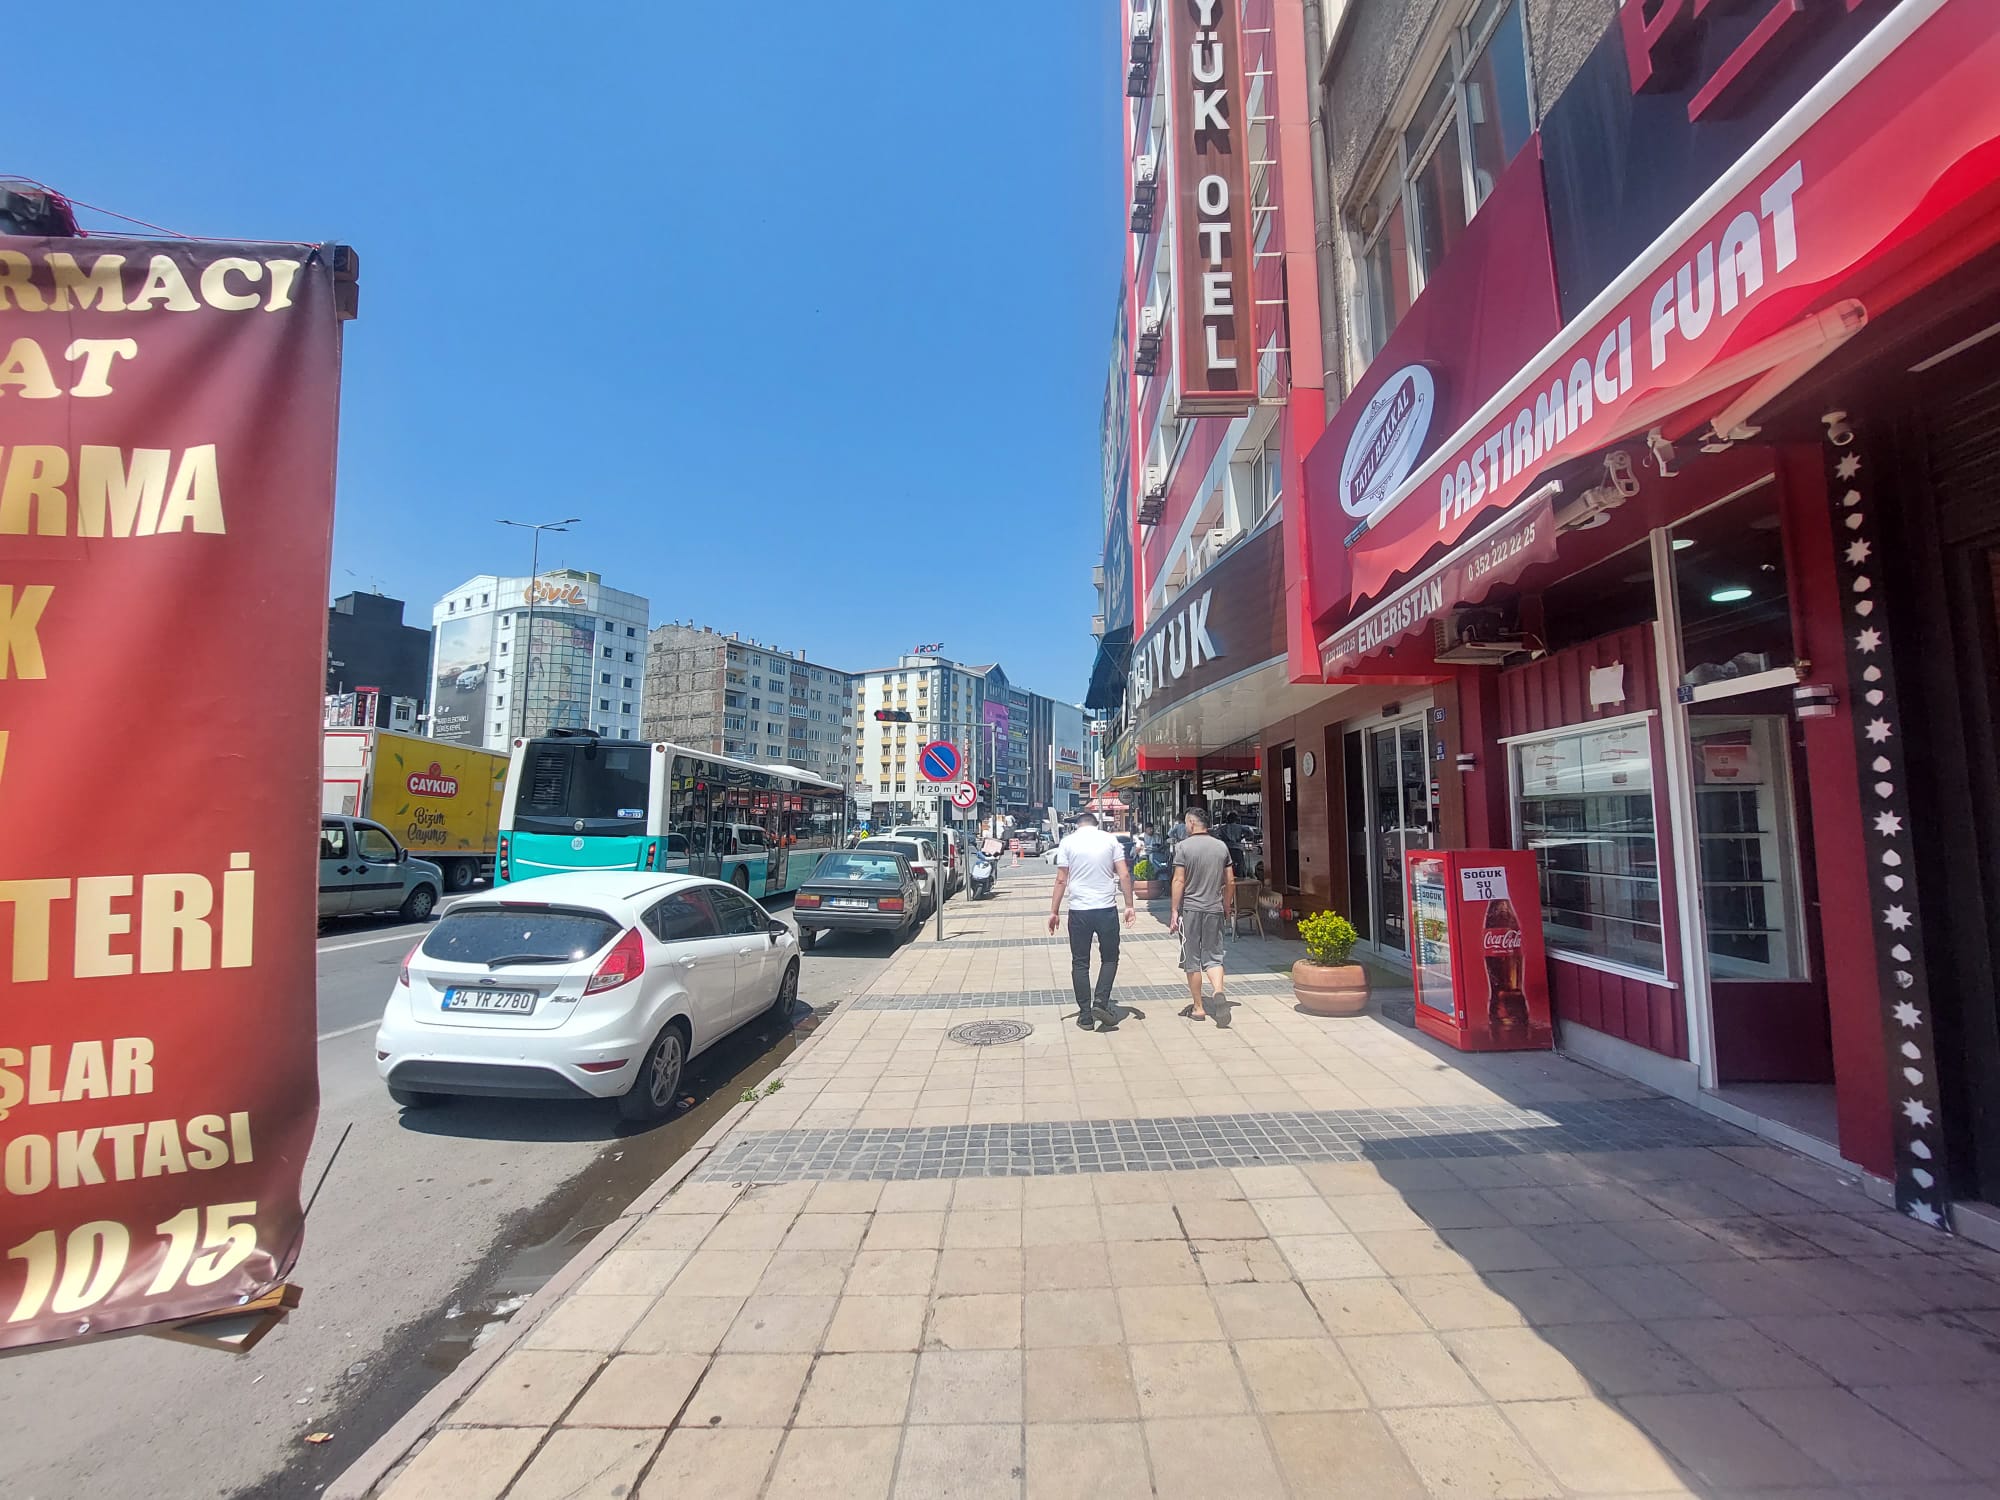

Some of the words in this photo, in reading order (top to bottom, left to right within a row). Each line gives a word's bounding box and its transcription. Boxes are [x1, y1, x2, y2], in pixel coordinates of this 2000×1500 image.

[1198, 174, 1238, 370] OTEL
[1438, 315, 1634, 531] PASTIRMACI
[1649, 160, 1804, 371] FUAT
[1375, 387, 1410, 463] BAKKAL
[1475, 555, 1491, 577] 352
[1491, 544, 1509, 568] 222
[1510, 533, 1522, 556] 22
[1524, 522, 1536, 544] 25
[919, 642, 945, 654] ROOF
[409, 776, 457, 795] ÇAYKUR
[927, 785, 940, 793] 20
[414, 806, 446, 829] Bizim
[1463, 869, 1503, 879] SOĞUK
[1476, 881, 1491, 889] SU
[0, 852, 255, 984] TERİ
[452, 992, 467, 1006] 34
[475, 992, 492, 1008] YR
[7, 1220, 130, 1324] 10
[144, 1200, 258, 1297] 15
